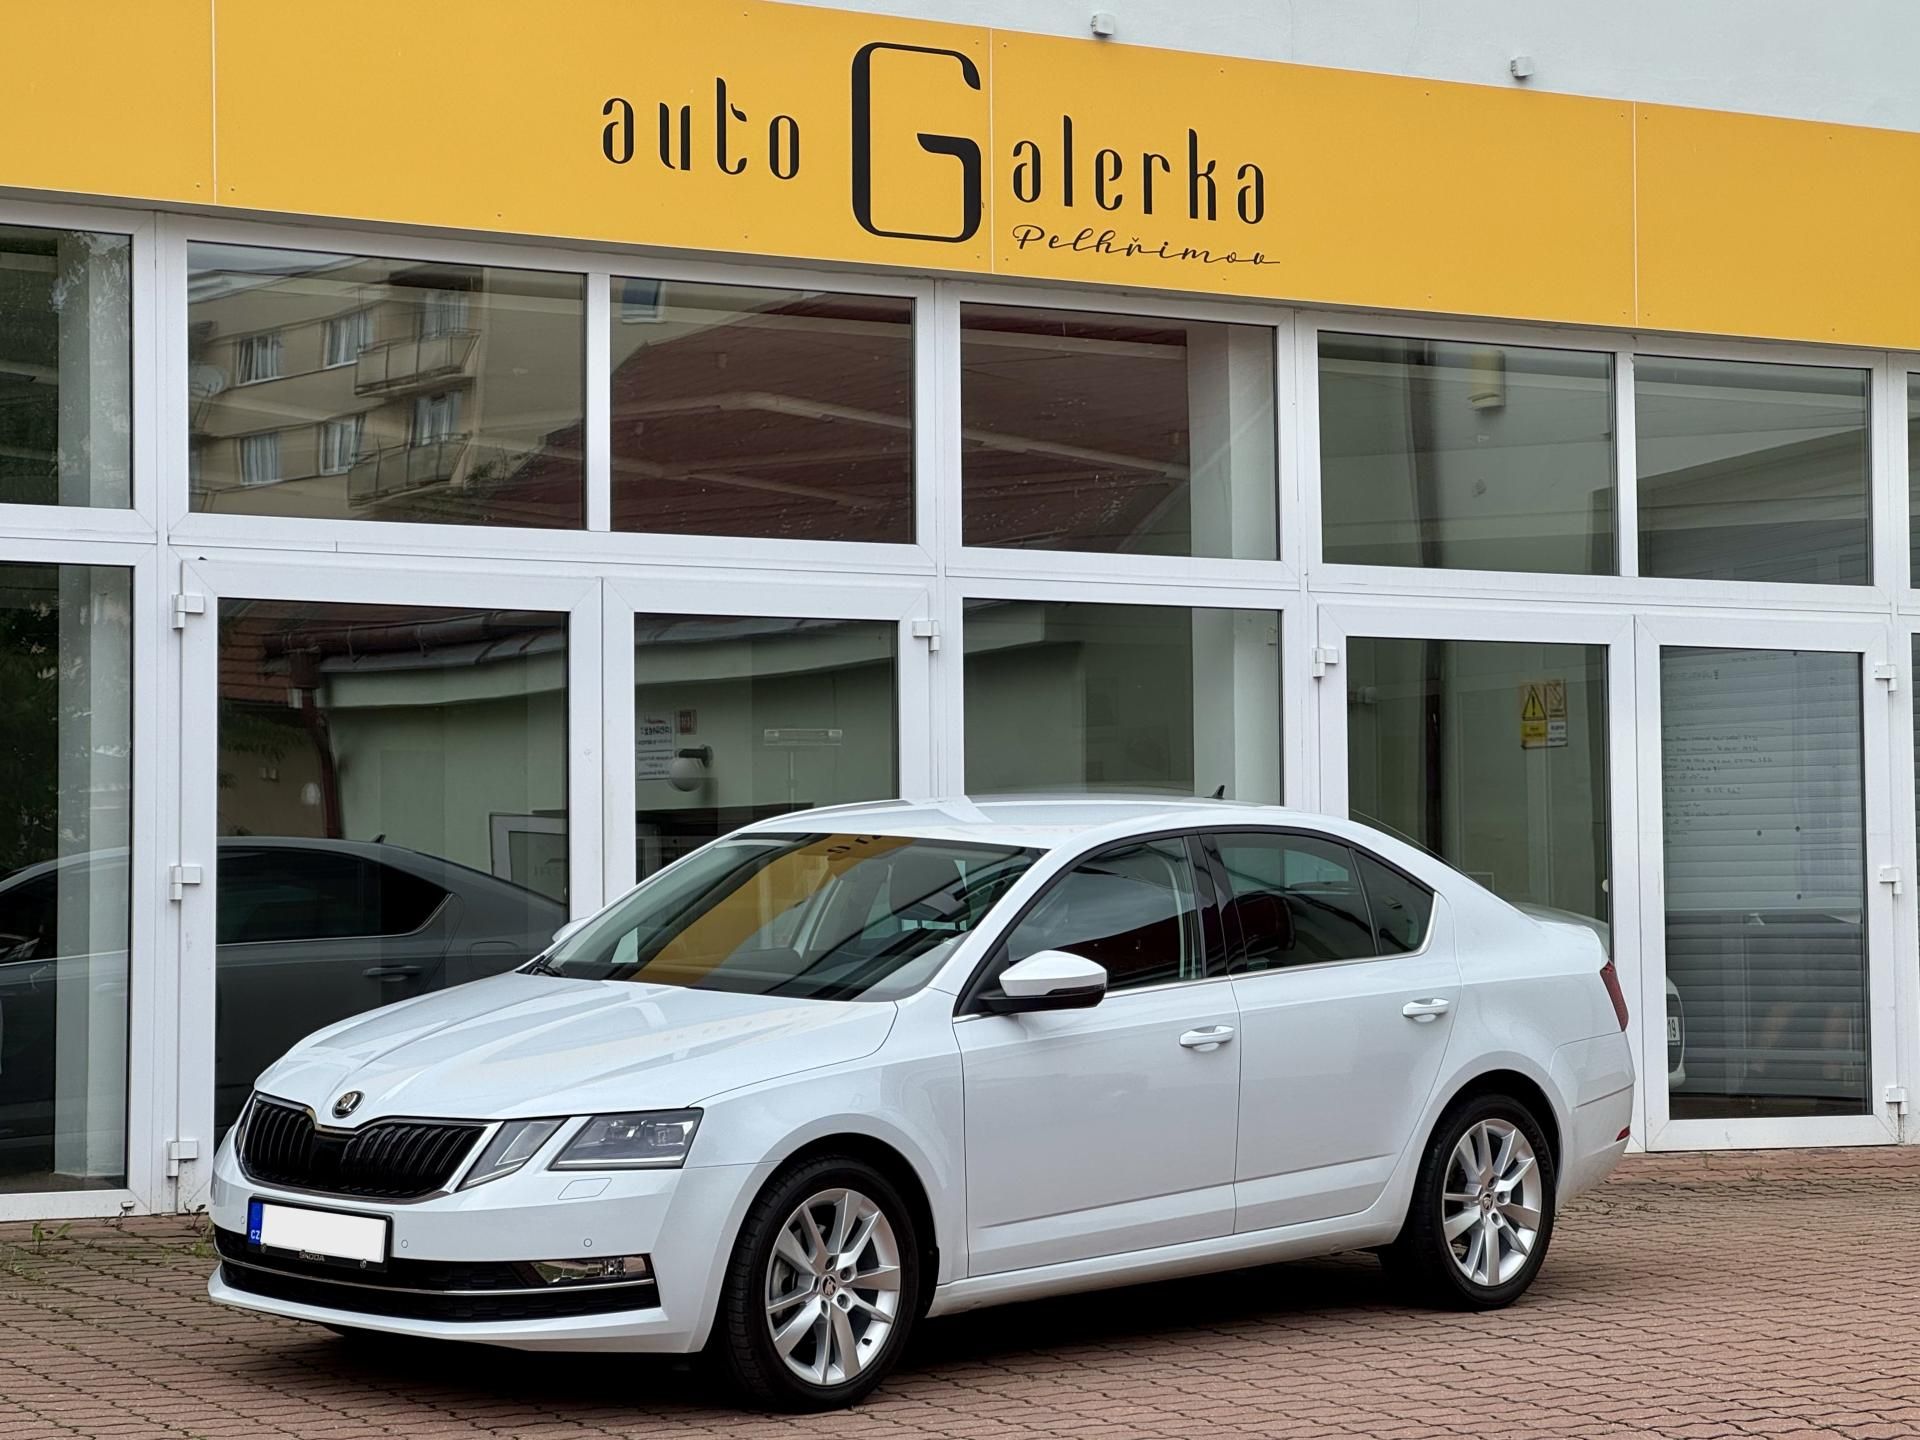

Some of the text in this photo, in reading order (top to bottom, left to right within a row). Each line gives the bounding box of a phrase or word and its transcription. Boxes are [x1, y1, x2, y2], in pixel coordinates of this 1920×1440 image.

[602, 77, 800, 180] auto
[1012, 224, 1281, 264] Pelhřimov
[250, 1229, 260, 1241] CZ
